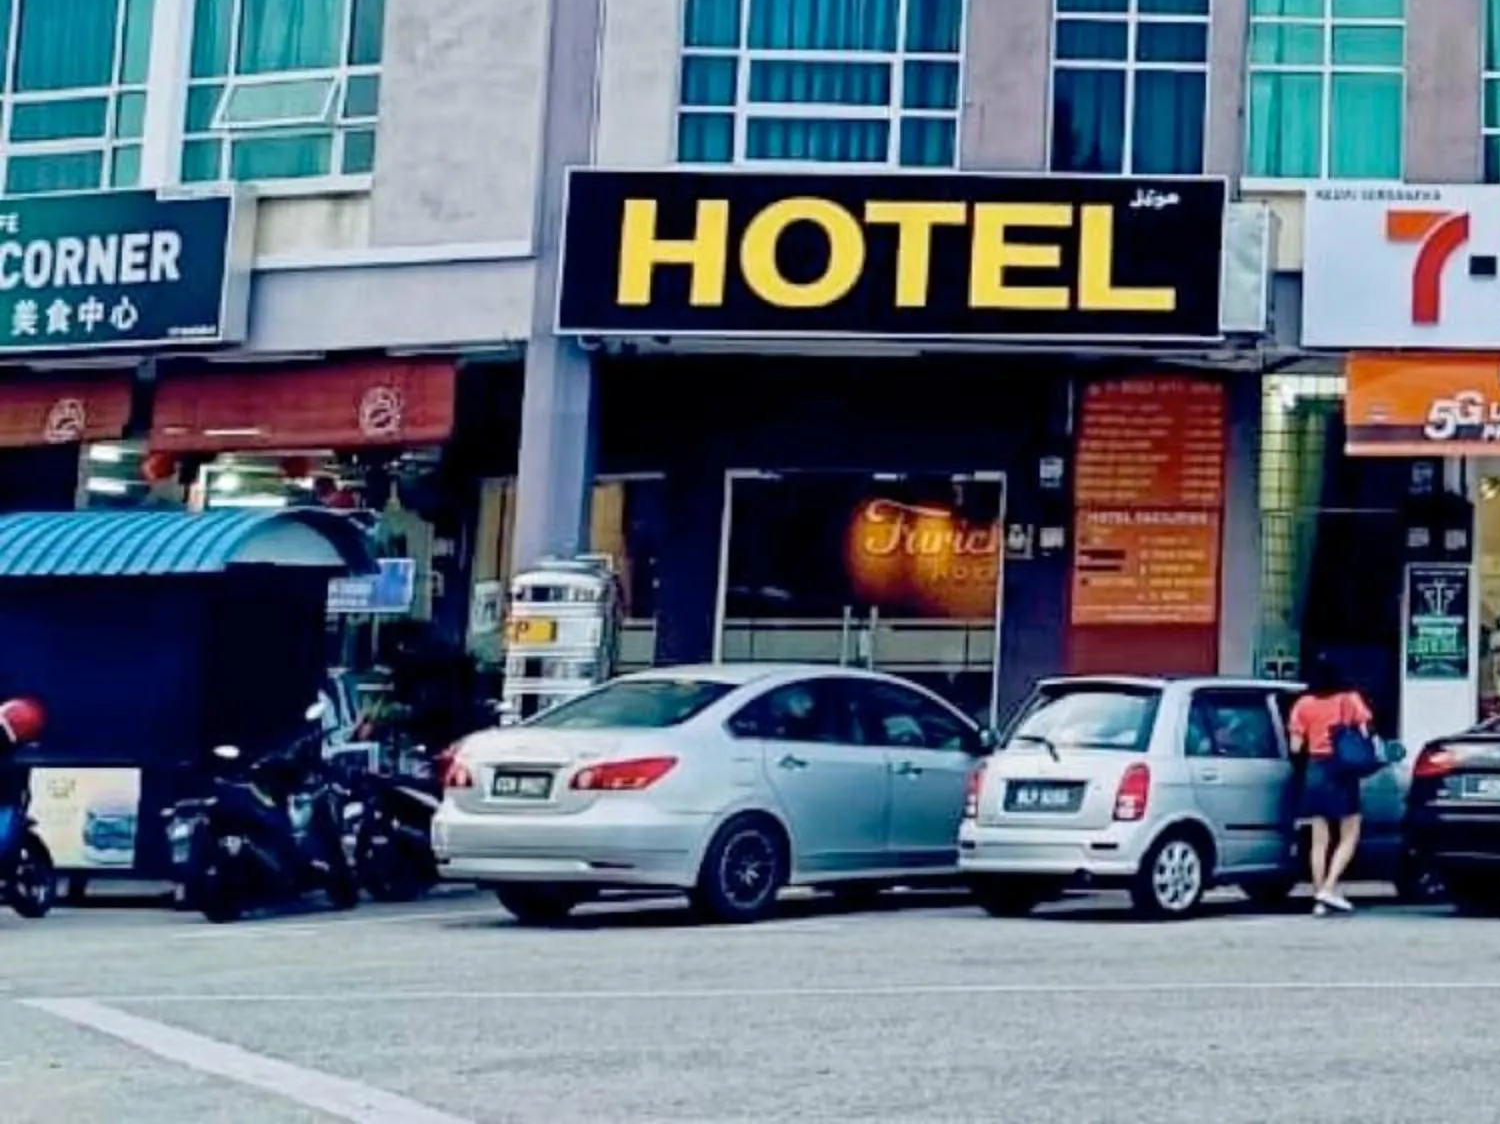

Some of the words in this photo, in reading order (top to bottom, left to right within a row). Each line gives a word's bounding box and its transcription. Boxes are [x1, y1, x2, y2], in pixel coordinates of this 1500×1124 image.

[0, 231, 181, 290] CORNER
[616, 196, 1177, 311] HOTEL
[12, 295, 139, 336] 美食中心
[1424, 389, 1486, 441] 5G
